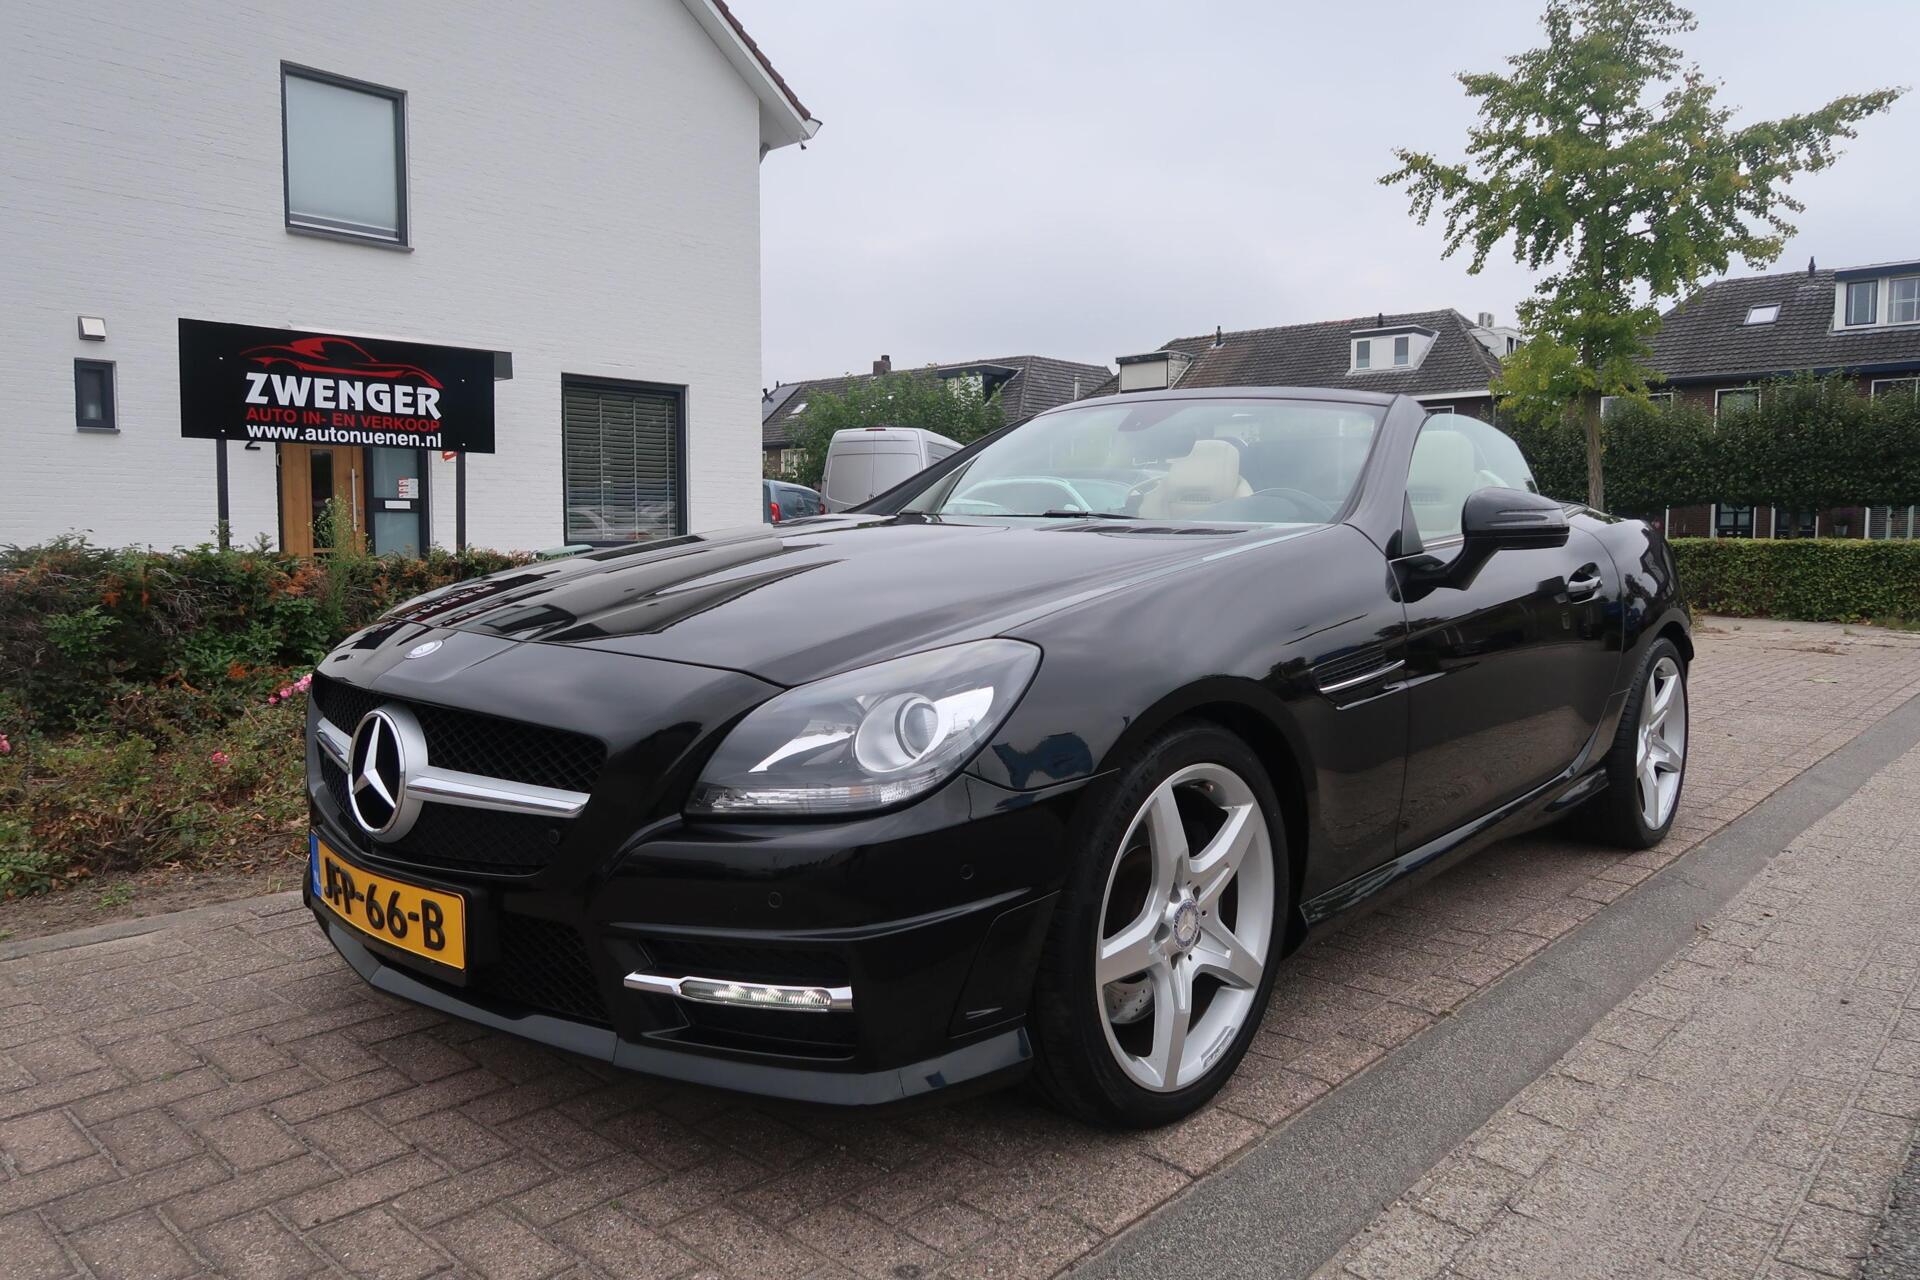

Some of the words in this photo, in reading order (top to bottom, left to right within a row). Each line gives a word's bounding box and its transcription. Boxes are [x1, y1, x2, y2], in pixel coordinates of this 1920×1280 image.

[245, 372, 442, 420] ZWENGER
[246, 407, 297, 424] AUTO
[303, 411, 327, 425] IN-
[332, 412, 355, 427] EN
[359, 415, 441, 432] VERKOOP
[246, 424, 442, 448] www.autonuenen.nl
[324, 857, 445, 951] JFP-66-B
